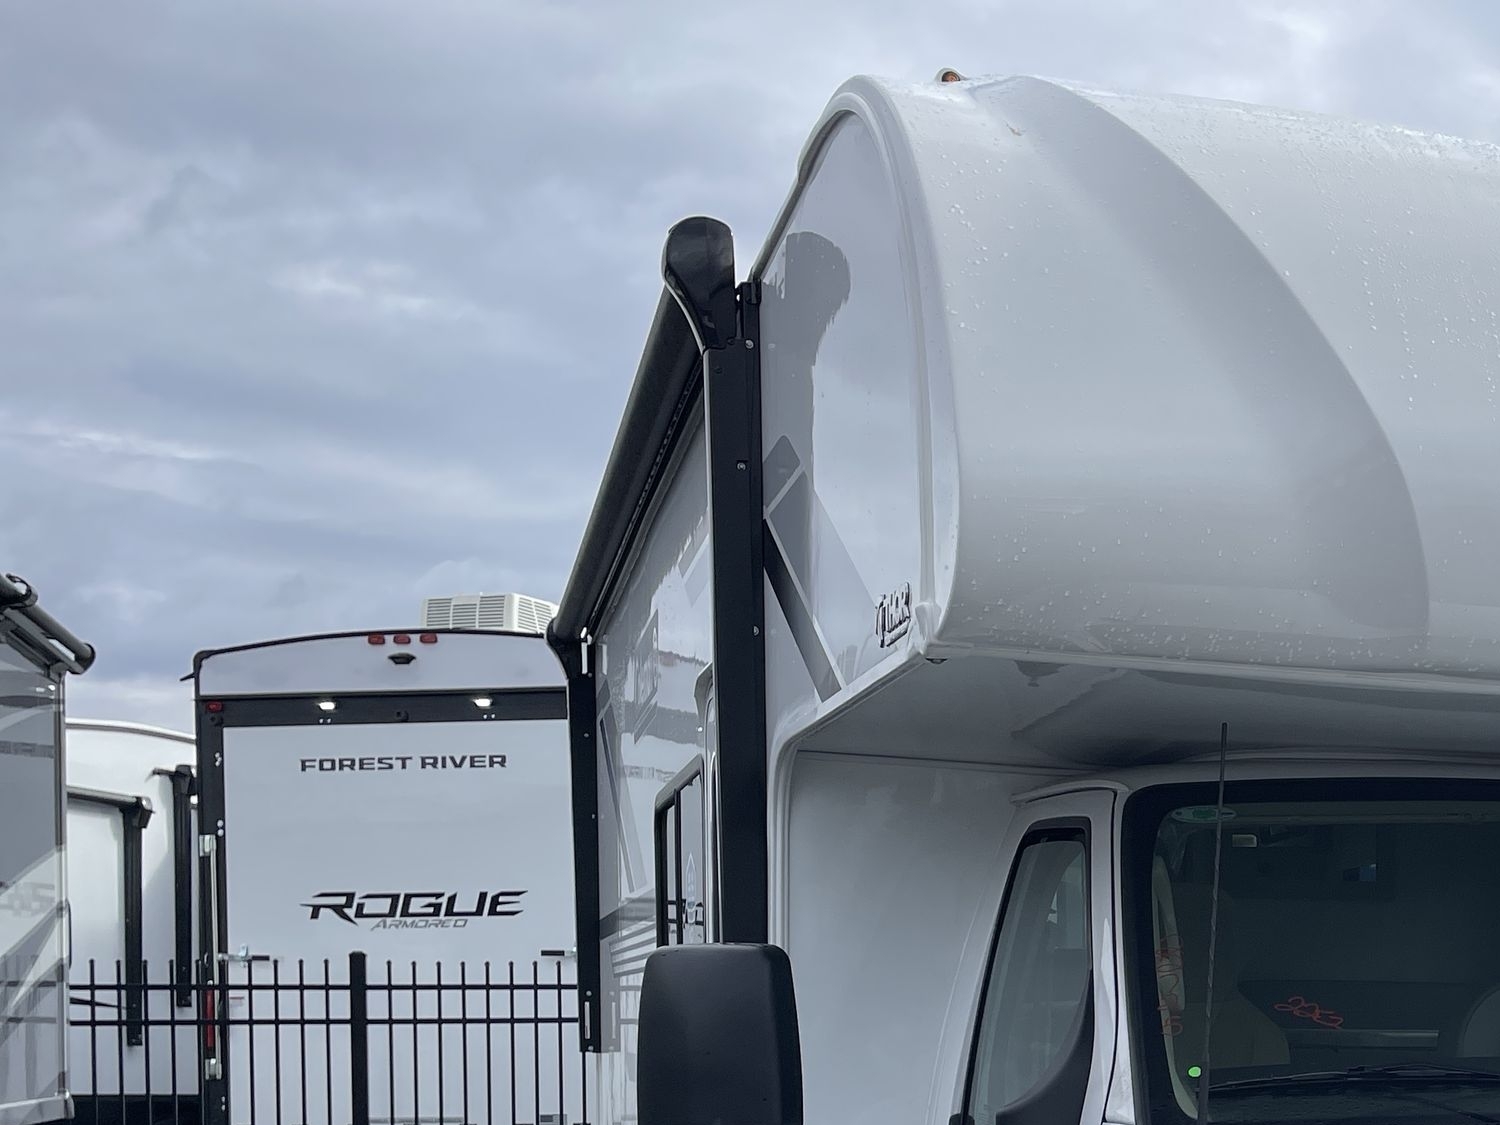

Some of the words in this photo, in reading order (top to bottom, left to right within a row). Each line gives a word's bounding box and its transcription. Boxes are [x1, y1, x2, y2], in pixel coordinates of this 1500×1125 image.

[299, 756, 413, 773] FOREST
[420, 754, 508, 770] RIVER
[299, 889, 529, 926] ROGUE
[369, 917, 469, 932] ARMORED
